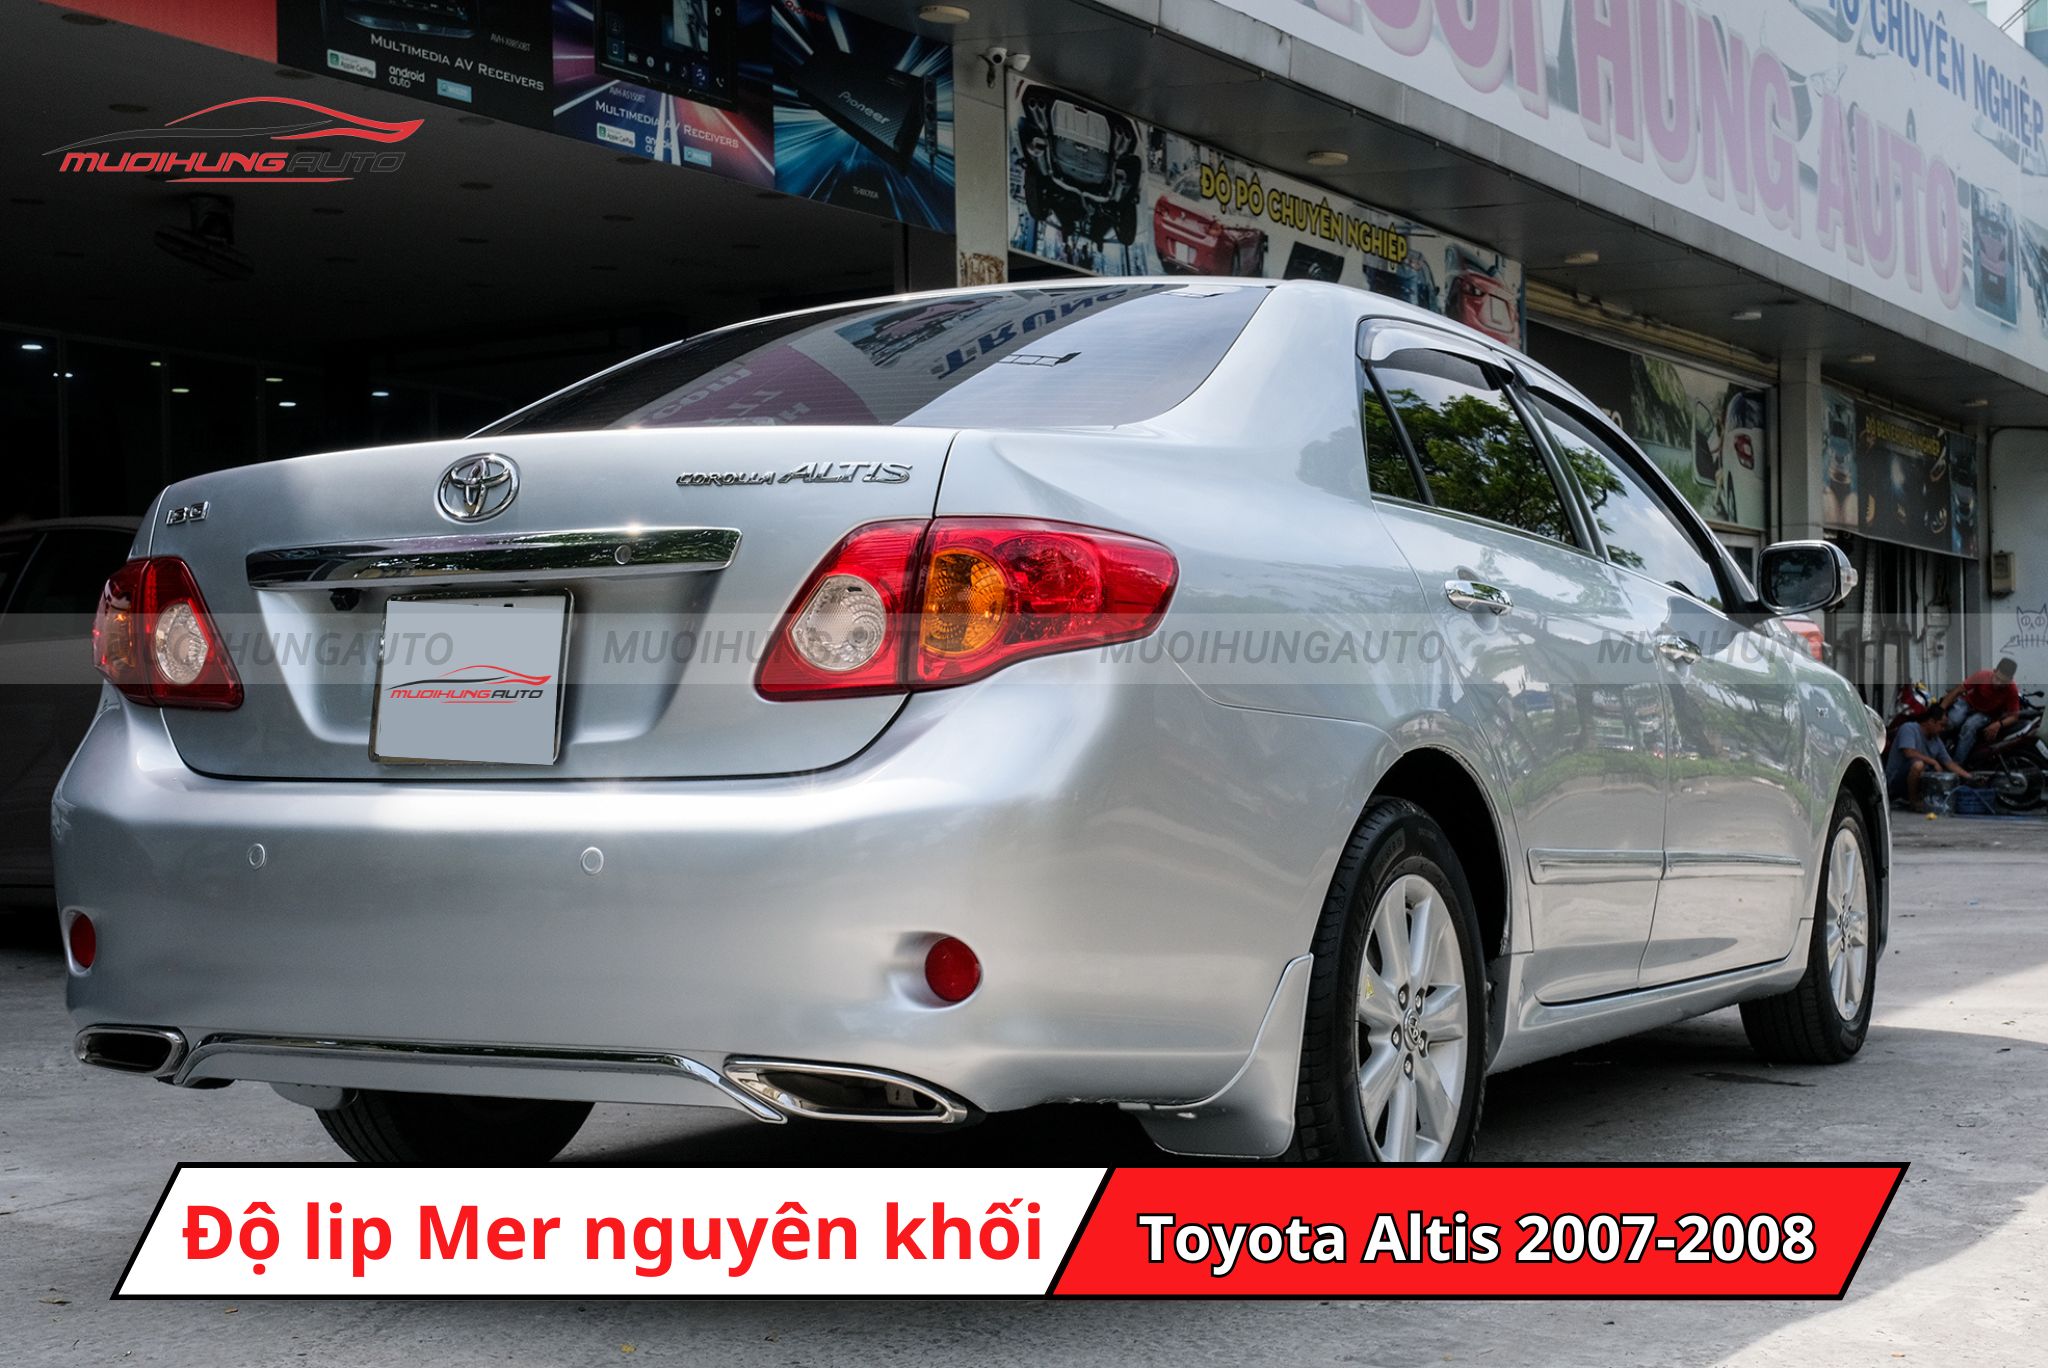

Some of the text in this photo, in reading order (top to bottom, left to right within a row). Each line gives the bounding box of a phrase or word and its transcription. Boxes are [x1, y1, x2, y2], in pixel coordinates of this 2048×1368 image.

[370, 33, 545, 92] MULTIMEDIA AV RECEIVERS
[389, 65, 425, 83] android
[1870, 0, 2044, 157] CHUYÊN NGHIỆP
[389, 76, 411, 89] auto
[838, 90, 891, 125] Pioneer
[683, 124, 740, 149] RECEIVERS
[1201, 160, 1408, 271] ĐỘ PÔ CHUYÊN NGHIỆP
[1816, 96, 1962, 311] AUTO
[676, 461, 913, 486] COROLLA ALTIS
